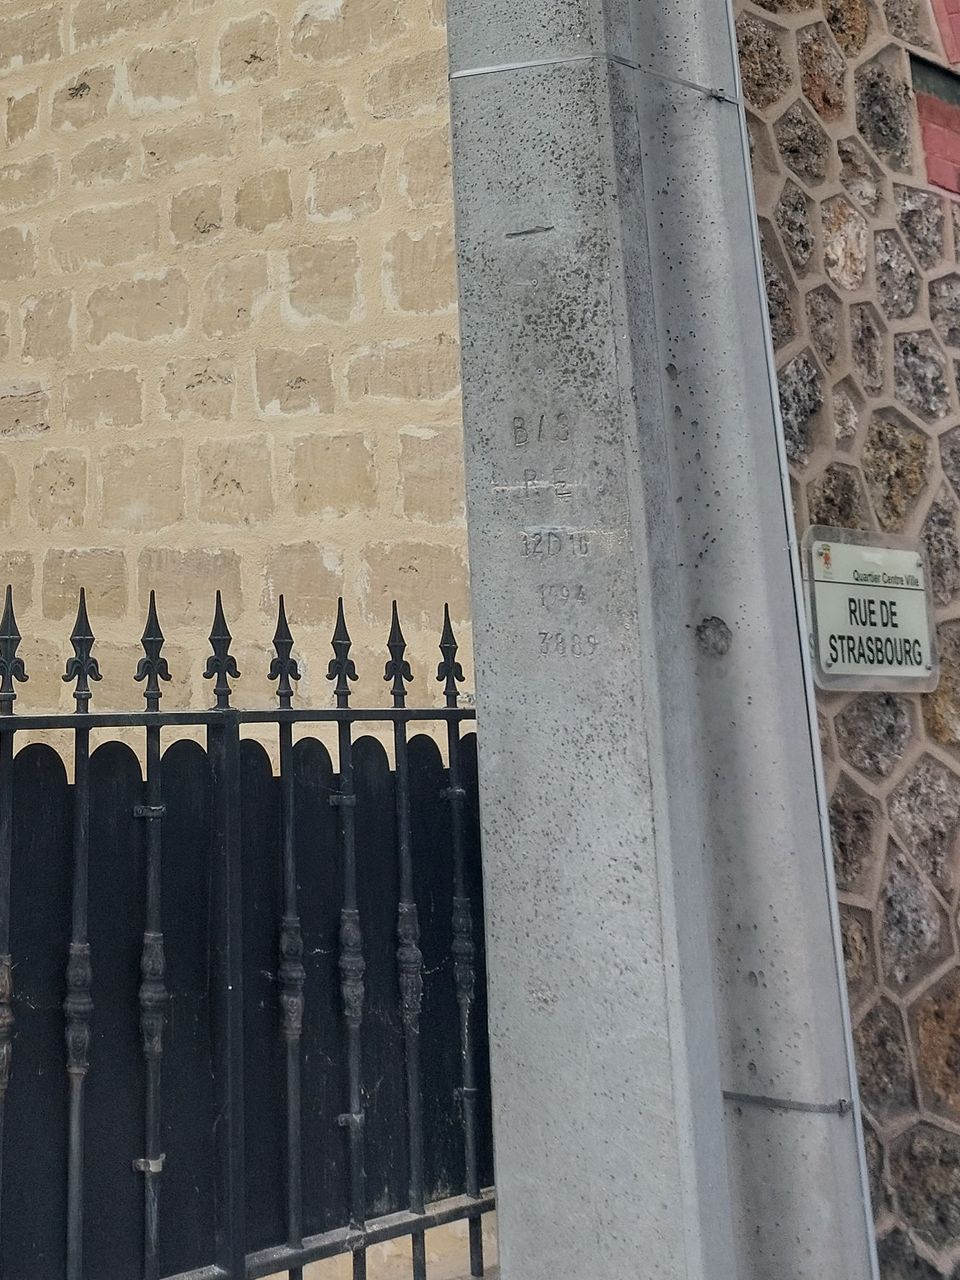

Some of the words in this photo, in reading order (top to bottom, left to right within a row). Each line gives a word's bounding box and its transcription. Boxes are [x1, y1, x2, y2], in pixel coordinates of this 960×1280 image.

[852, 569, 881, 584] Quartier
[882, 572, 904, 586] Centre
[904, 574, 919, 587] Ville
[848, 597, 877, 627] RUE
[880, 600, 899, 628] DE
[829, 634, 923, 666] STRASBOURG
